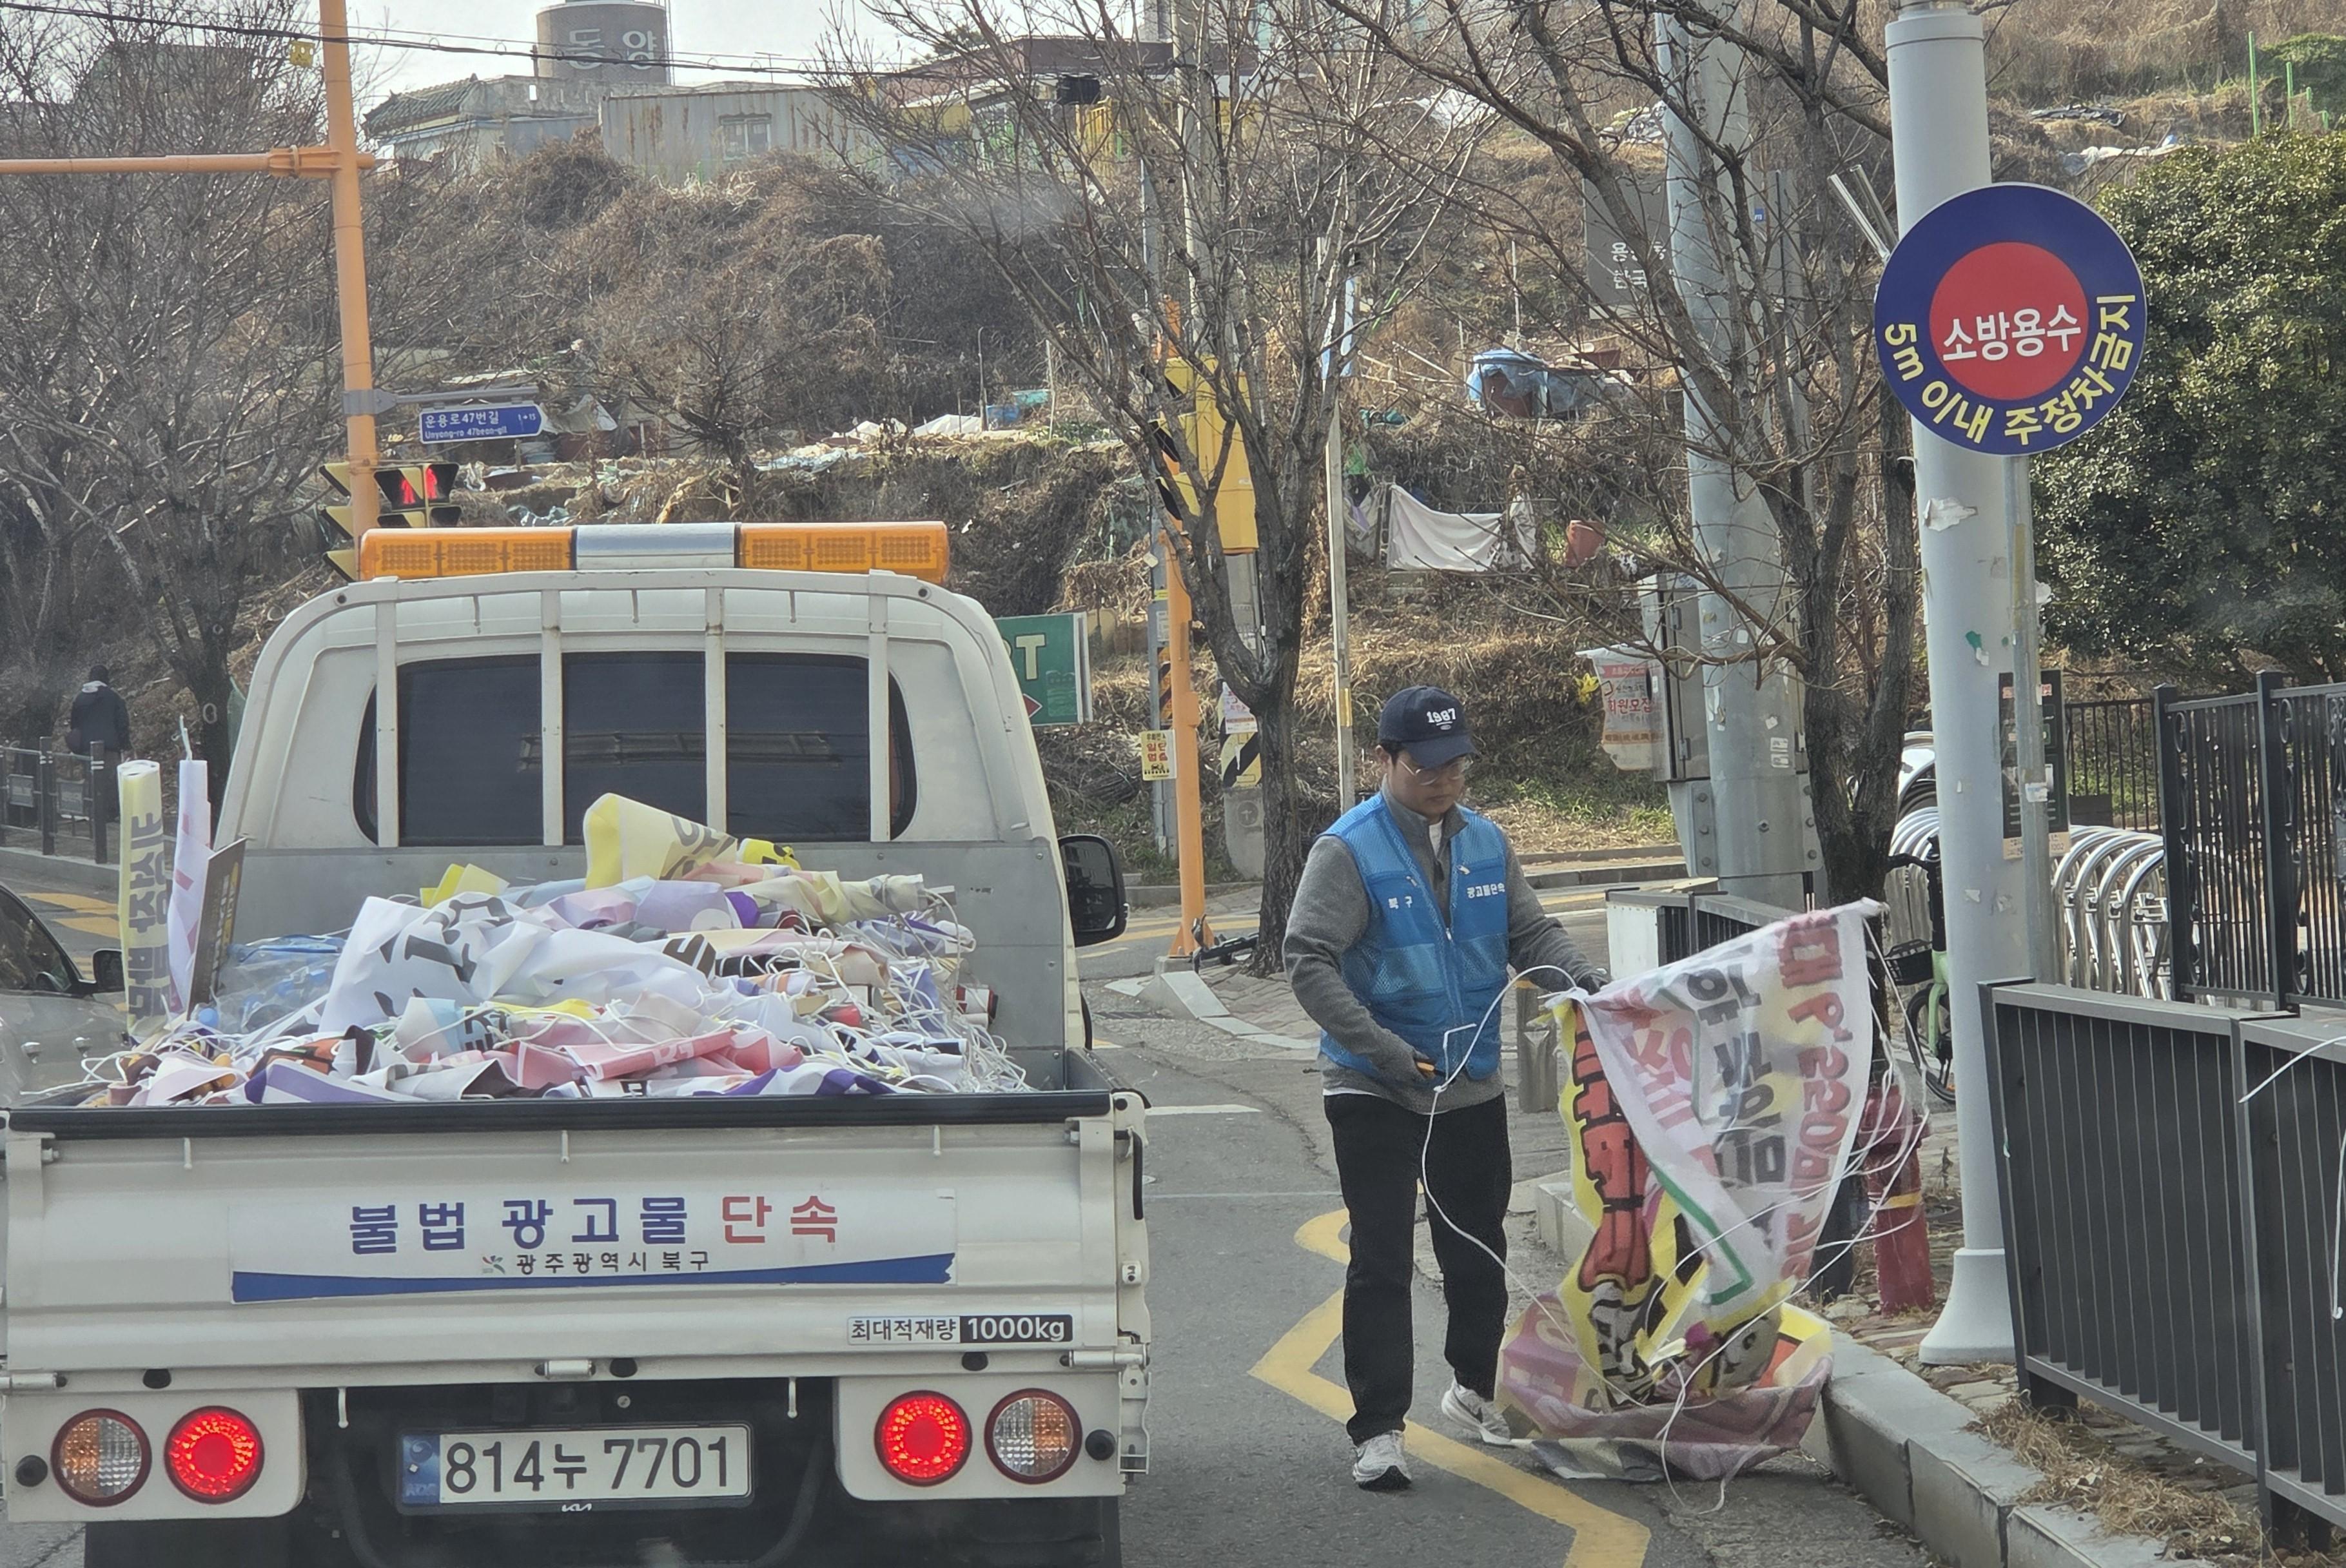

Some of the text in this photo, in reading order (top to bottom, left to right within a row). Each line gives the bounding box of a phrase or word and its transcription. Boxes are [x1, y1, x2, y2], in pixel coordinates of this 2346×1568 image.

[566, 28, 657, 70] 동양
[1942, 304, 2082, 361] 소방용수
[1884, 295, 2135, 446] 5m 이내 주정차금지
[425, 410, 500, 429] 운용로47번길
[425, 426, 507, 440] Unyong-ro 47beon-gil
[1426, 707, 1456, 723] 1987
[349, 1195, 838, 1255] 불법 광고물 단속
[516, 1251, 709, 1275] 광주광역시 북구
[851, 1317, 1065, 1342] 최대적재량 1000kg
[445, 1435, 727, 1494] 814누 7701
